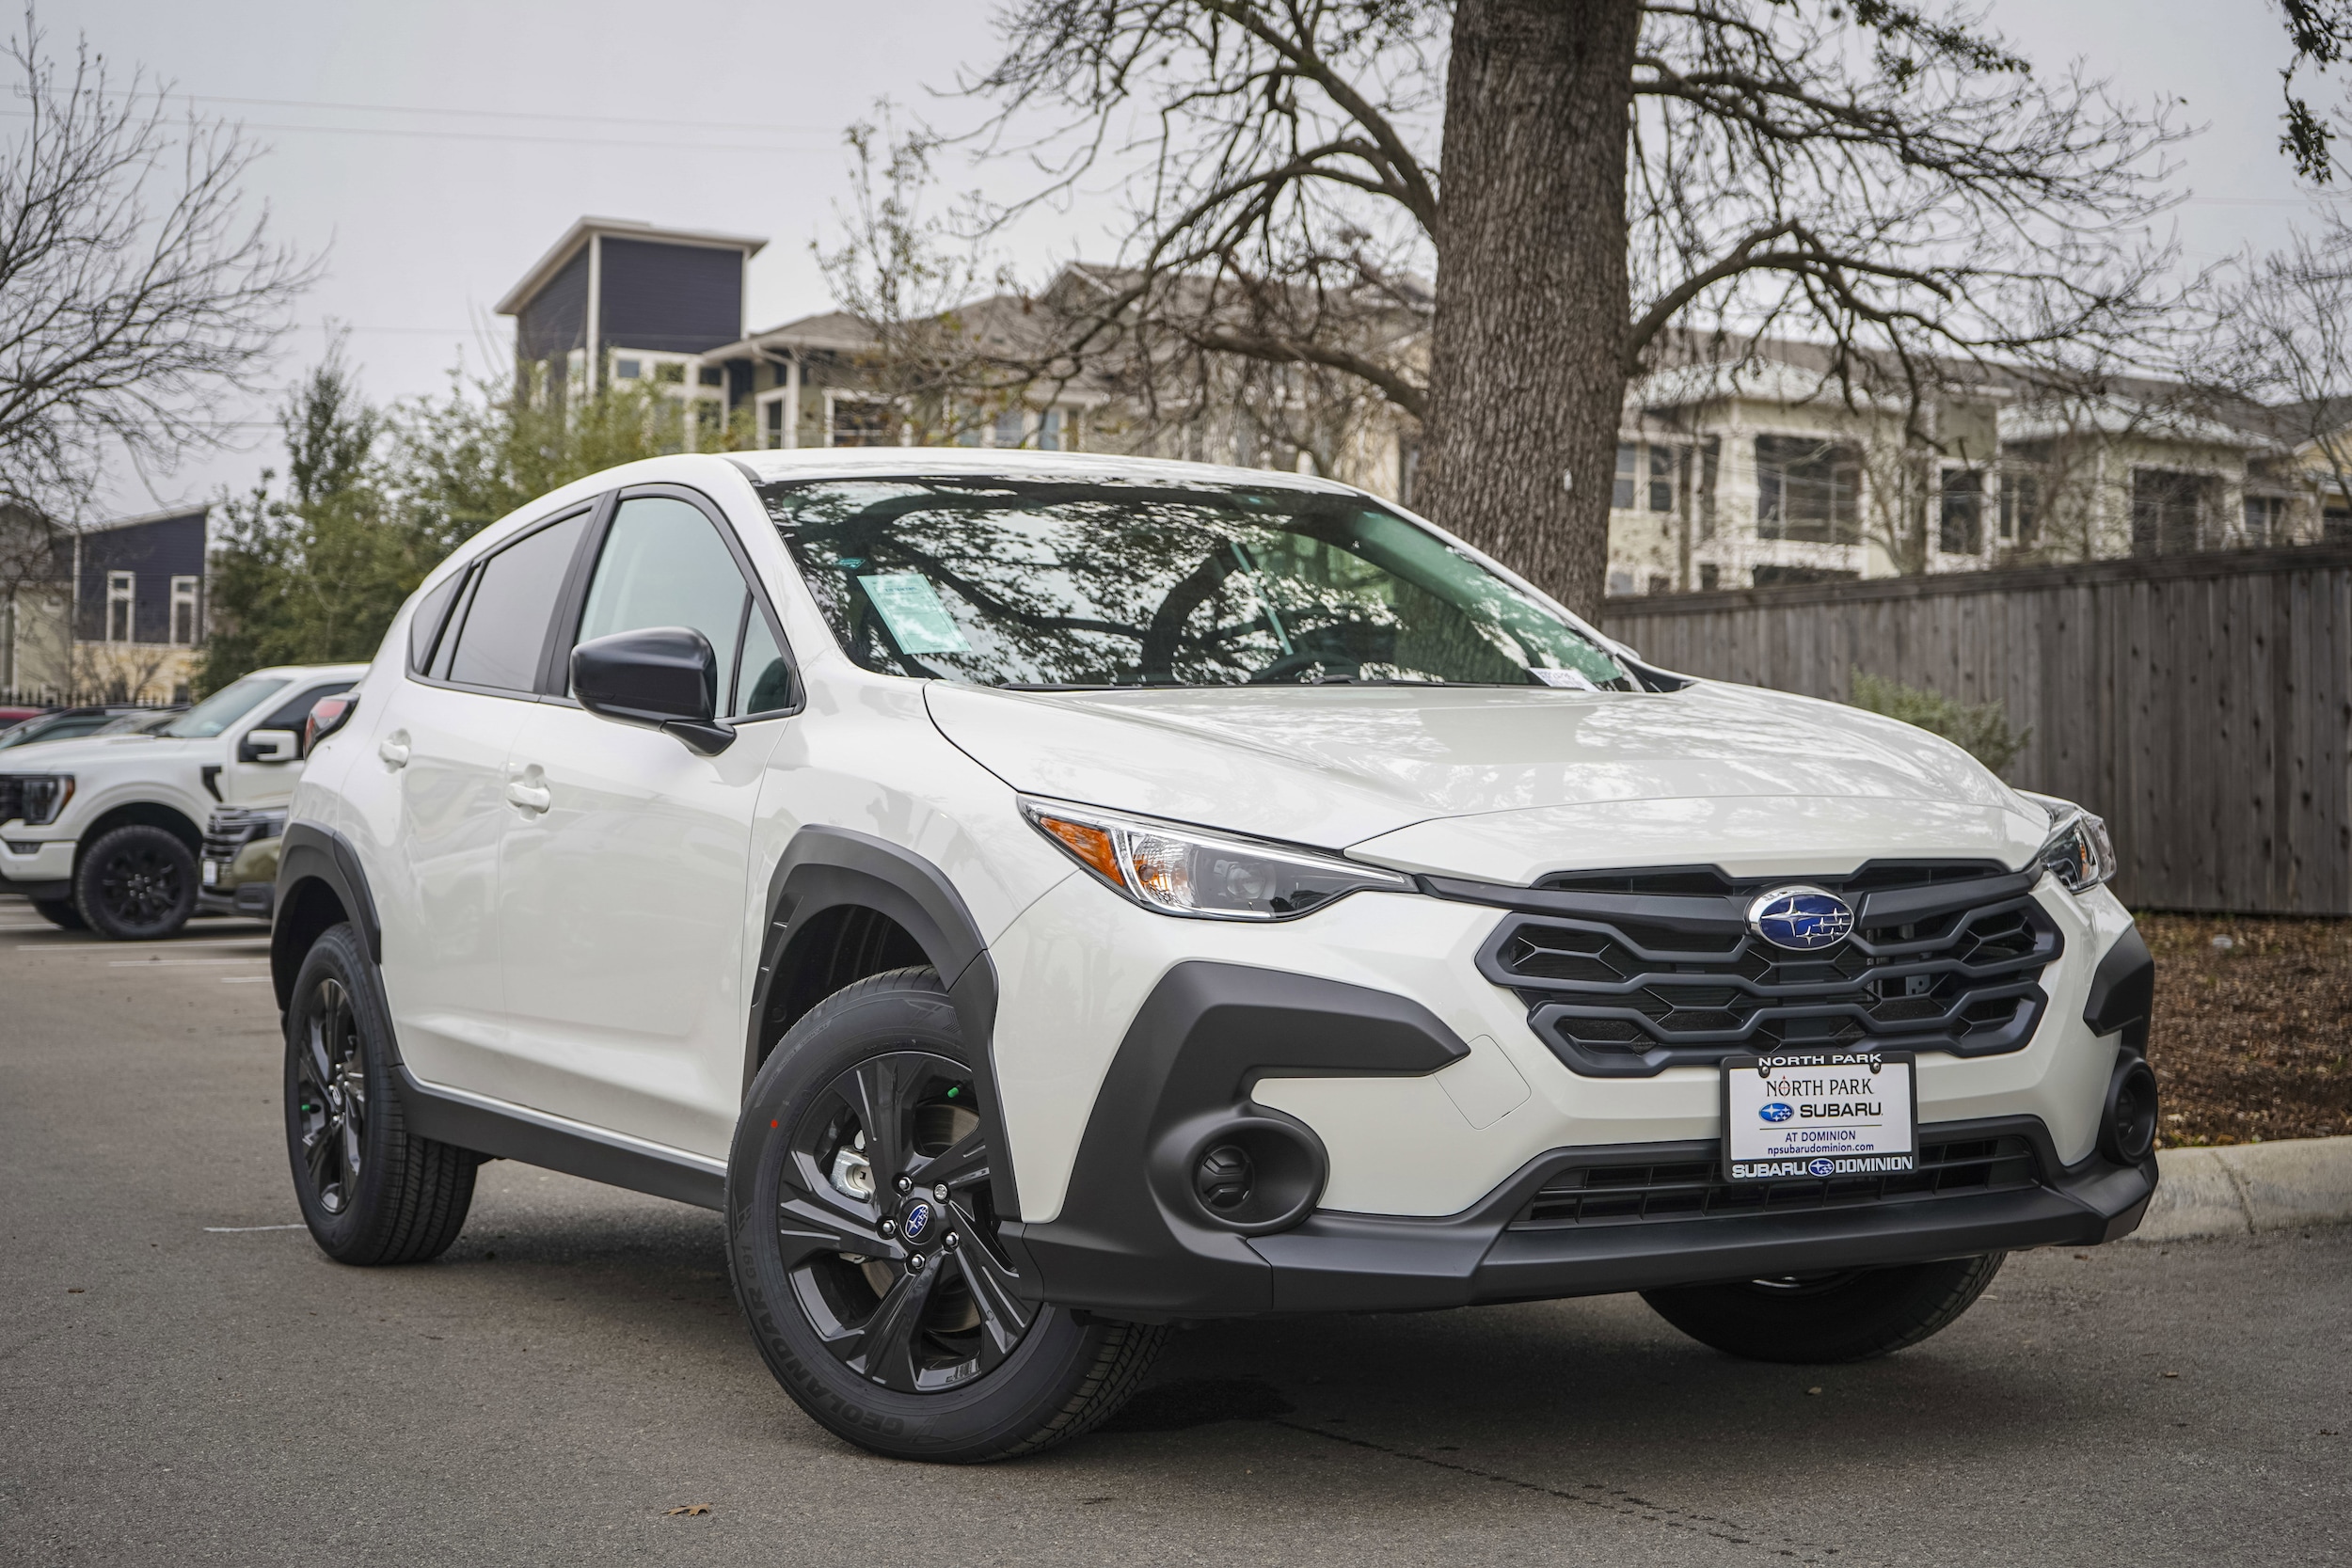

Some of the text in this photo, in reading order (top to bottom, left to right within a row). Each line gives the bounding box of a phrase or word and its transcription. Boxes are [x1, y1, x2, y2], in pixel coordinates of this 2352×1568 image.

[1758, 1053, 1882, 1067] NORTH PARK
[1767, 1078, 1874, 1097] NORTH PARK
[1800, 1102, 1882, 1117] SUBARU
[1785, 1131, 1856, 1143] AT DOMINION
[1768, 1143, 1874, 1157] npsubarudominion.com
[1732, 1156, 1913, 1178] SUBARU DOMINION
[741, 1244, 758, 1279] G91
[749, 1288, 904, 1436] GEOLANDAR
